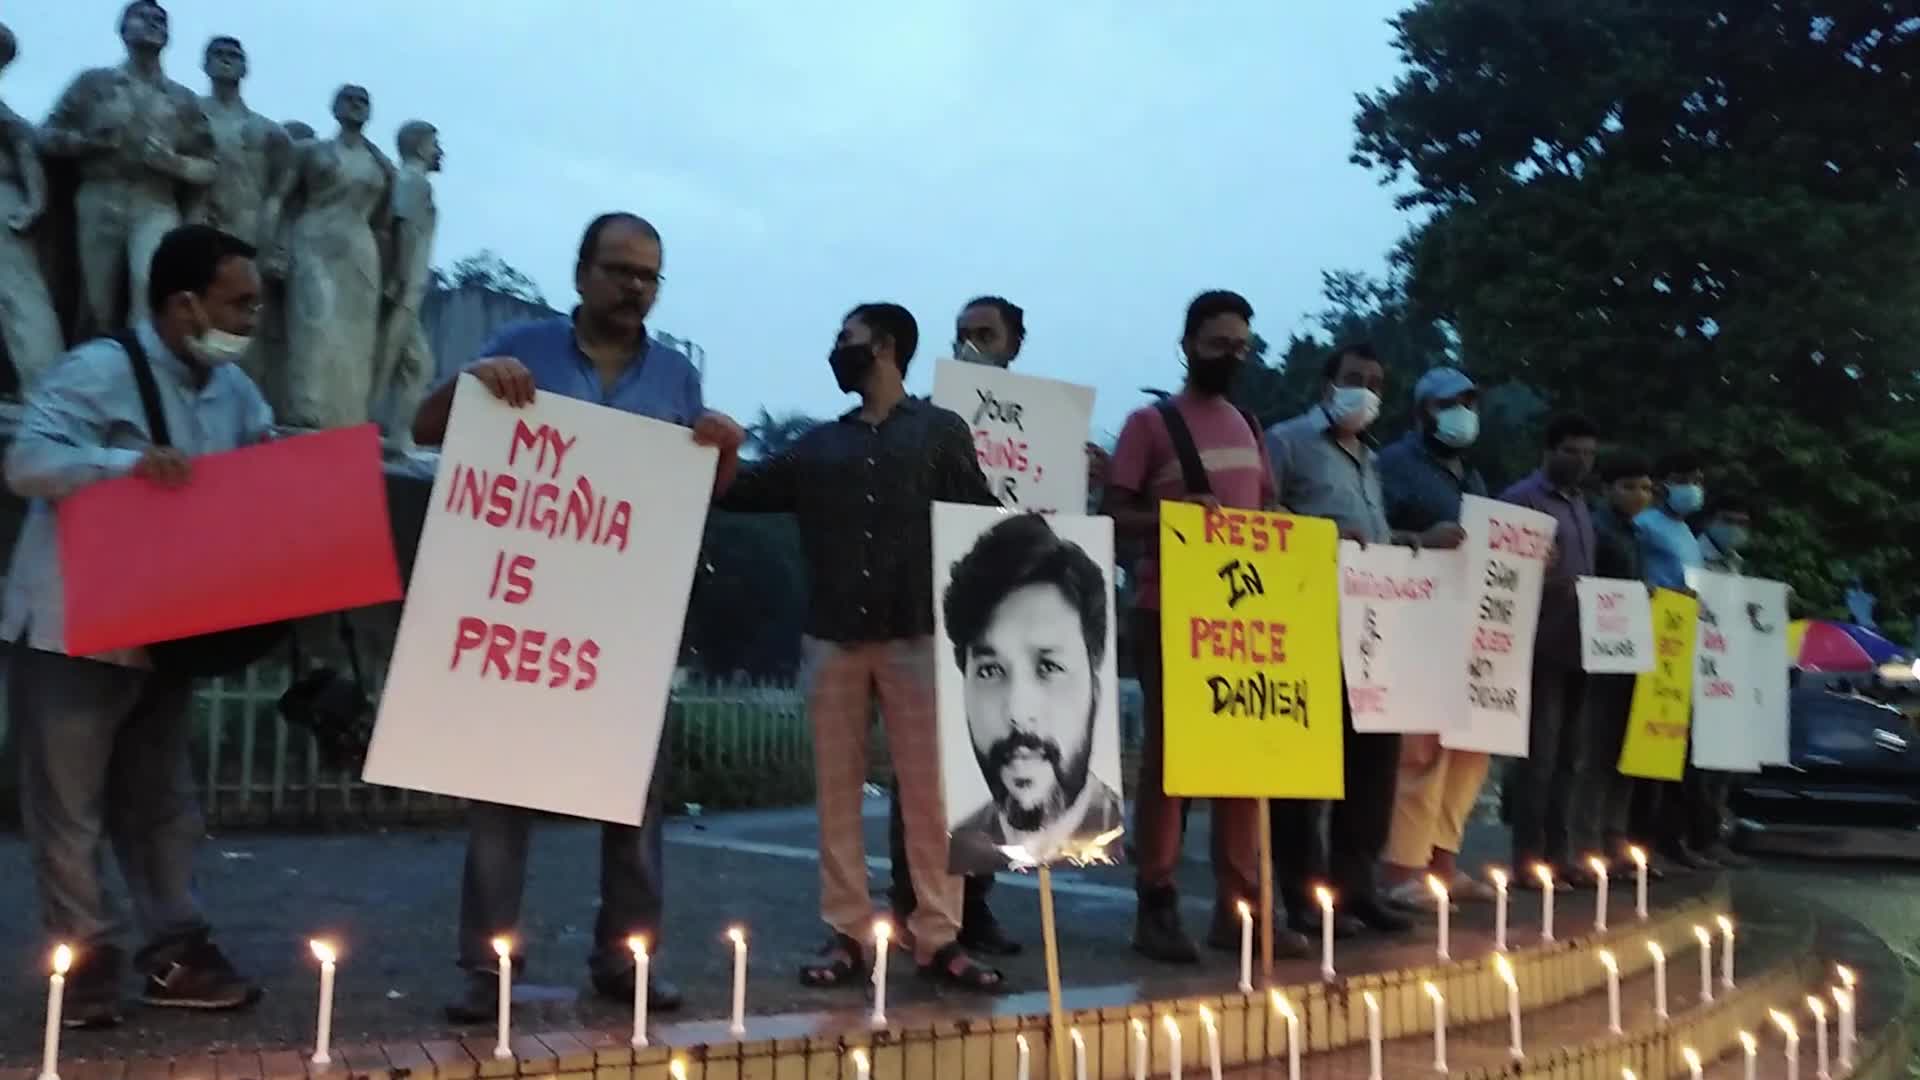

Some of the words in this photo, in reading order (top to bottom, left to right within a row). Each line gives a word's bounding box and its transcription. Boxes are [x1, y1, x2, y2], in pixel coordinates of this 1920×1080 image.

[973, 387, 1024, 432] YOUR
[508, 416, 576, 480] MY
[446, 462, 632, 553] INSIGNIA
[1203, 508, 1294, 553] REST
[489, 551, 536, 605] IS
[1217, 558, 1264, 609] IN
[449, 615, 601, 691] PRESS
[1189, 616, 1287, 664] PEACE
[1206, 671, 1309, 729] DANISH
